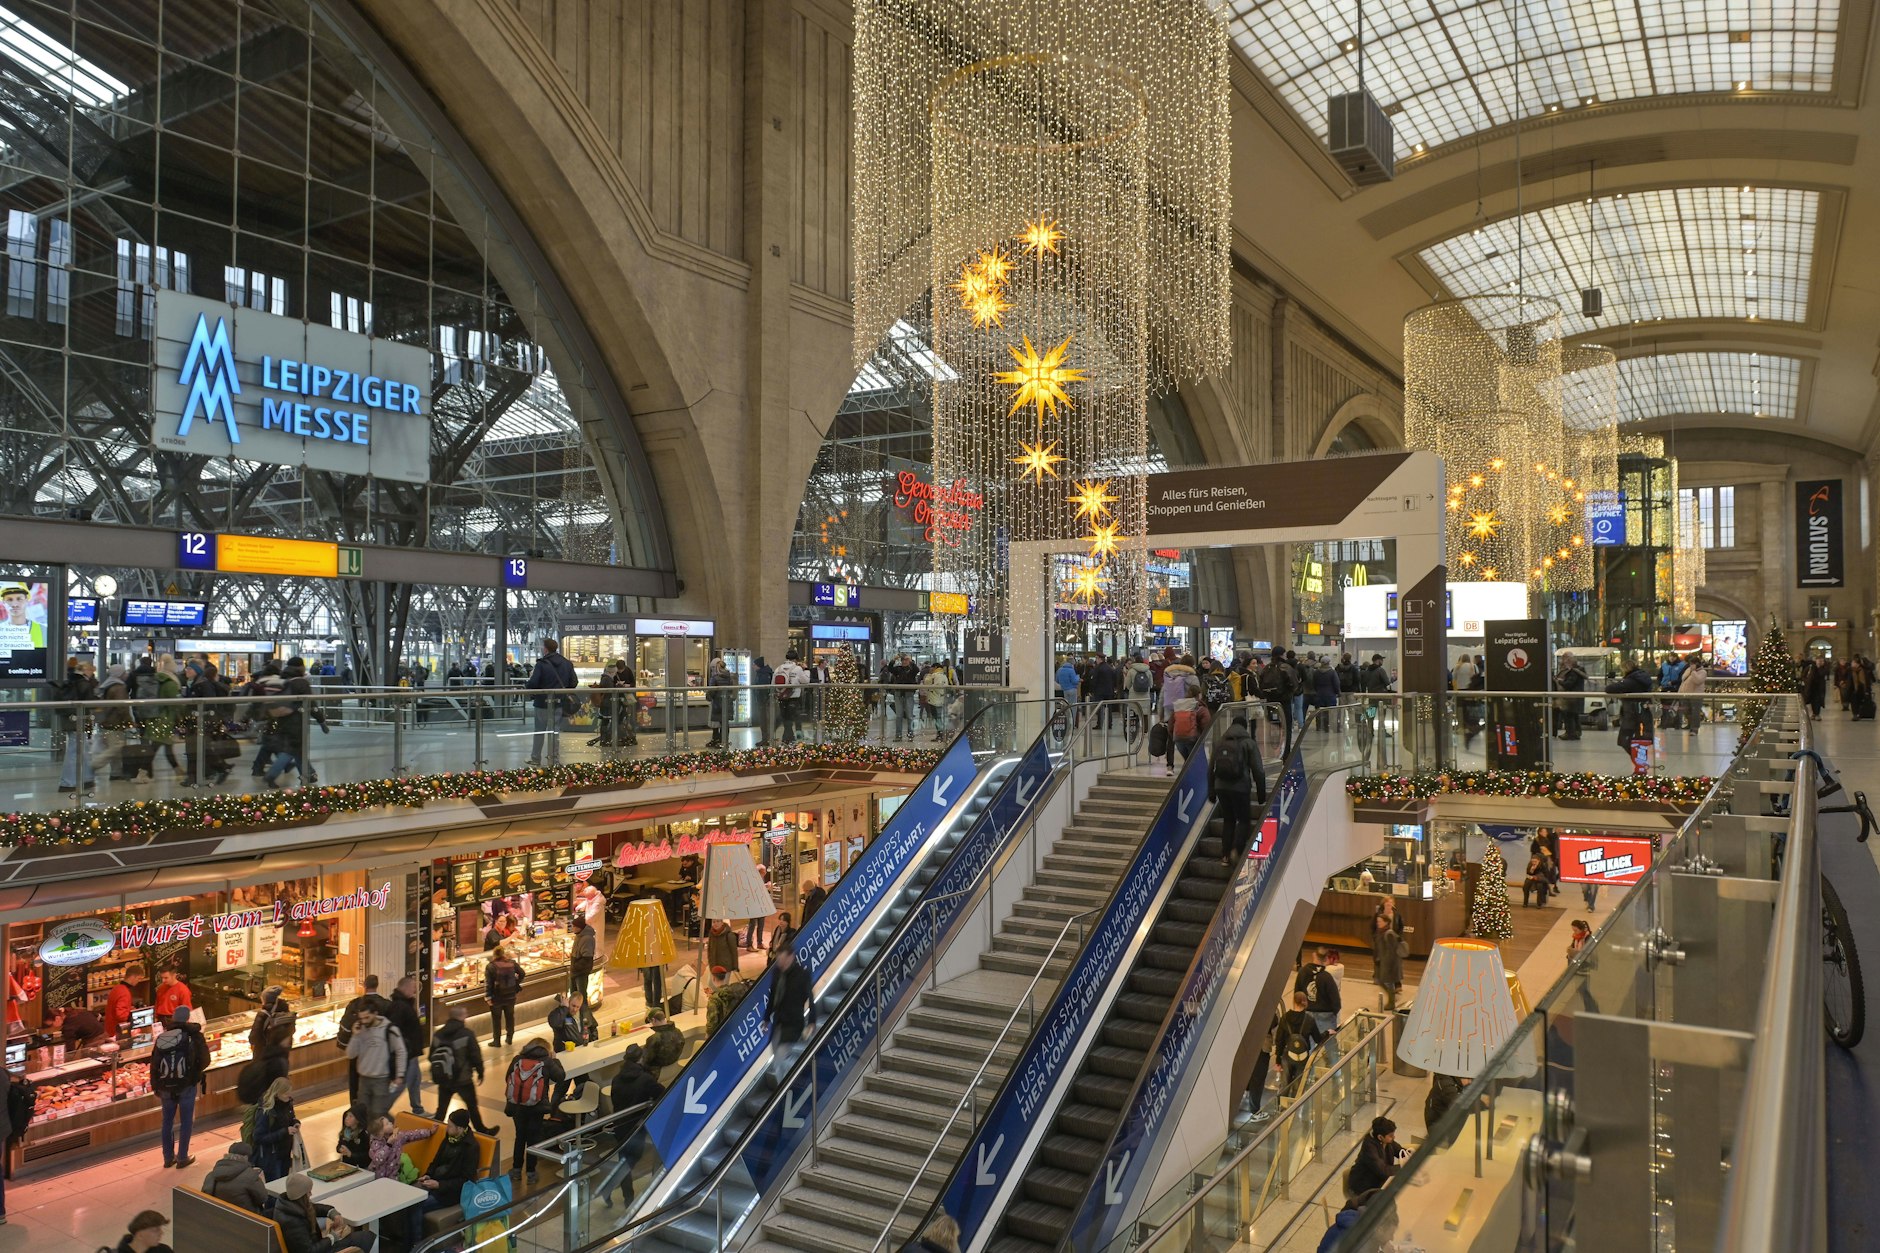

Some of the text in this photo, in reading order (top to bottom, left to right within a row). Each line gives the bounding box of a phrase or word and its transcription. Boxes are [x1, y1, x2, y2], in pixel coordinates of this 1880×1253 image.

[261, 354, 422, 416] LEIPZIGER
[261, 397, 370, 445] MESSE
[1162, 486, 1248, 500] Alles fürs Reisen,
[1148, 498, 1266, 517] Shoppen und Genießen
[182, 532, 206, 555] 12
[1809, 516, 1829, 575] SATURN
[509, 559, 526, 576] 13
[821, 585, 831, 594] 1-2
[848, 586, 858, 599] 14
[606, 623, 627, 631] MITNEHMEN
[1406, 627, 1419, 635] WC
[1465, 622, 1478, 630] DB
[1494, 637, 1518, 645] Leipzig
[968, 656, 1001, 665] EINFACH
[985, 665, 1001, 673] GUT
[973, 673, 1000, 681] FINDEN
[1579, 847, 1604, 863] KAUF
[1585, 854, 1633, 875] KEIN KACK
[810, 873, 884, 972] ABWECHSLUNG
[883, 858, 895, 878] IN
[893, 822, 925, 865] FAHRT.
[121, 913, 204, 950] Wurst
[212, 910, 263, 937] vom
[274, 882, 391, 928] Bauernhof
[225, 932, 244, 940] Curry-
[225, 938, 243, 946] wurst
[731, 1002, 761, 1047] LUST
[838, 893, 851, 914] IN
[850, 874, 867, 899] 140
[866, 830, 901, 878] SHOPS?
[827, 1012, 856, 1057] LUST
[857, 982, 877, 1019] AUF
[878, 913, 928, 988] SHOPPING
[953, 832, 987, 883] SHOPS?
[1015, 852, 1153, 1105] LUST AUF SHOPPING IN 140 SHOPS?
[1020, 841, 1173, 1122] HIER KOMMT ABWECHSLUNG IN FAHRT.
[833, 1031, 863, 1073] HIER
[861, 974, 901, 1034] KOMMT
[1139, 1065, 1162, 1119] LUST
[1162, 1029, 1178, 1072] AUF
[1178, 950, 1216, 1035] SHOPPING
[1215, 931, 1225, 954] IN
[1144, 1086, 1168, 1137] HIER
[1166, 1018, 1196, 1090] KOMMT
[1196, 908, 1248, 1025] ABWECHSLUNG
